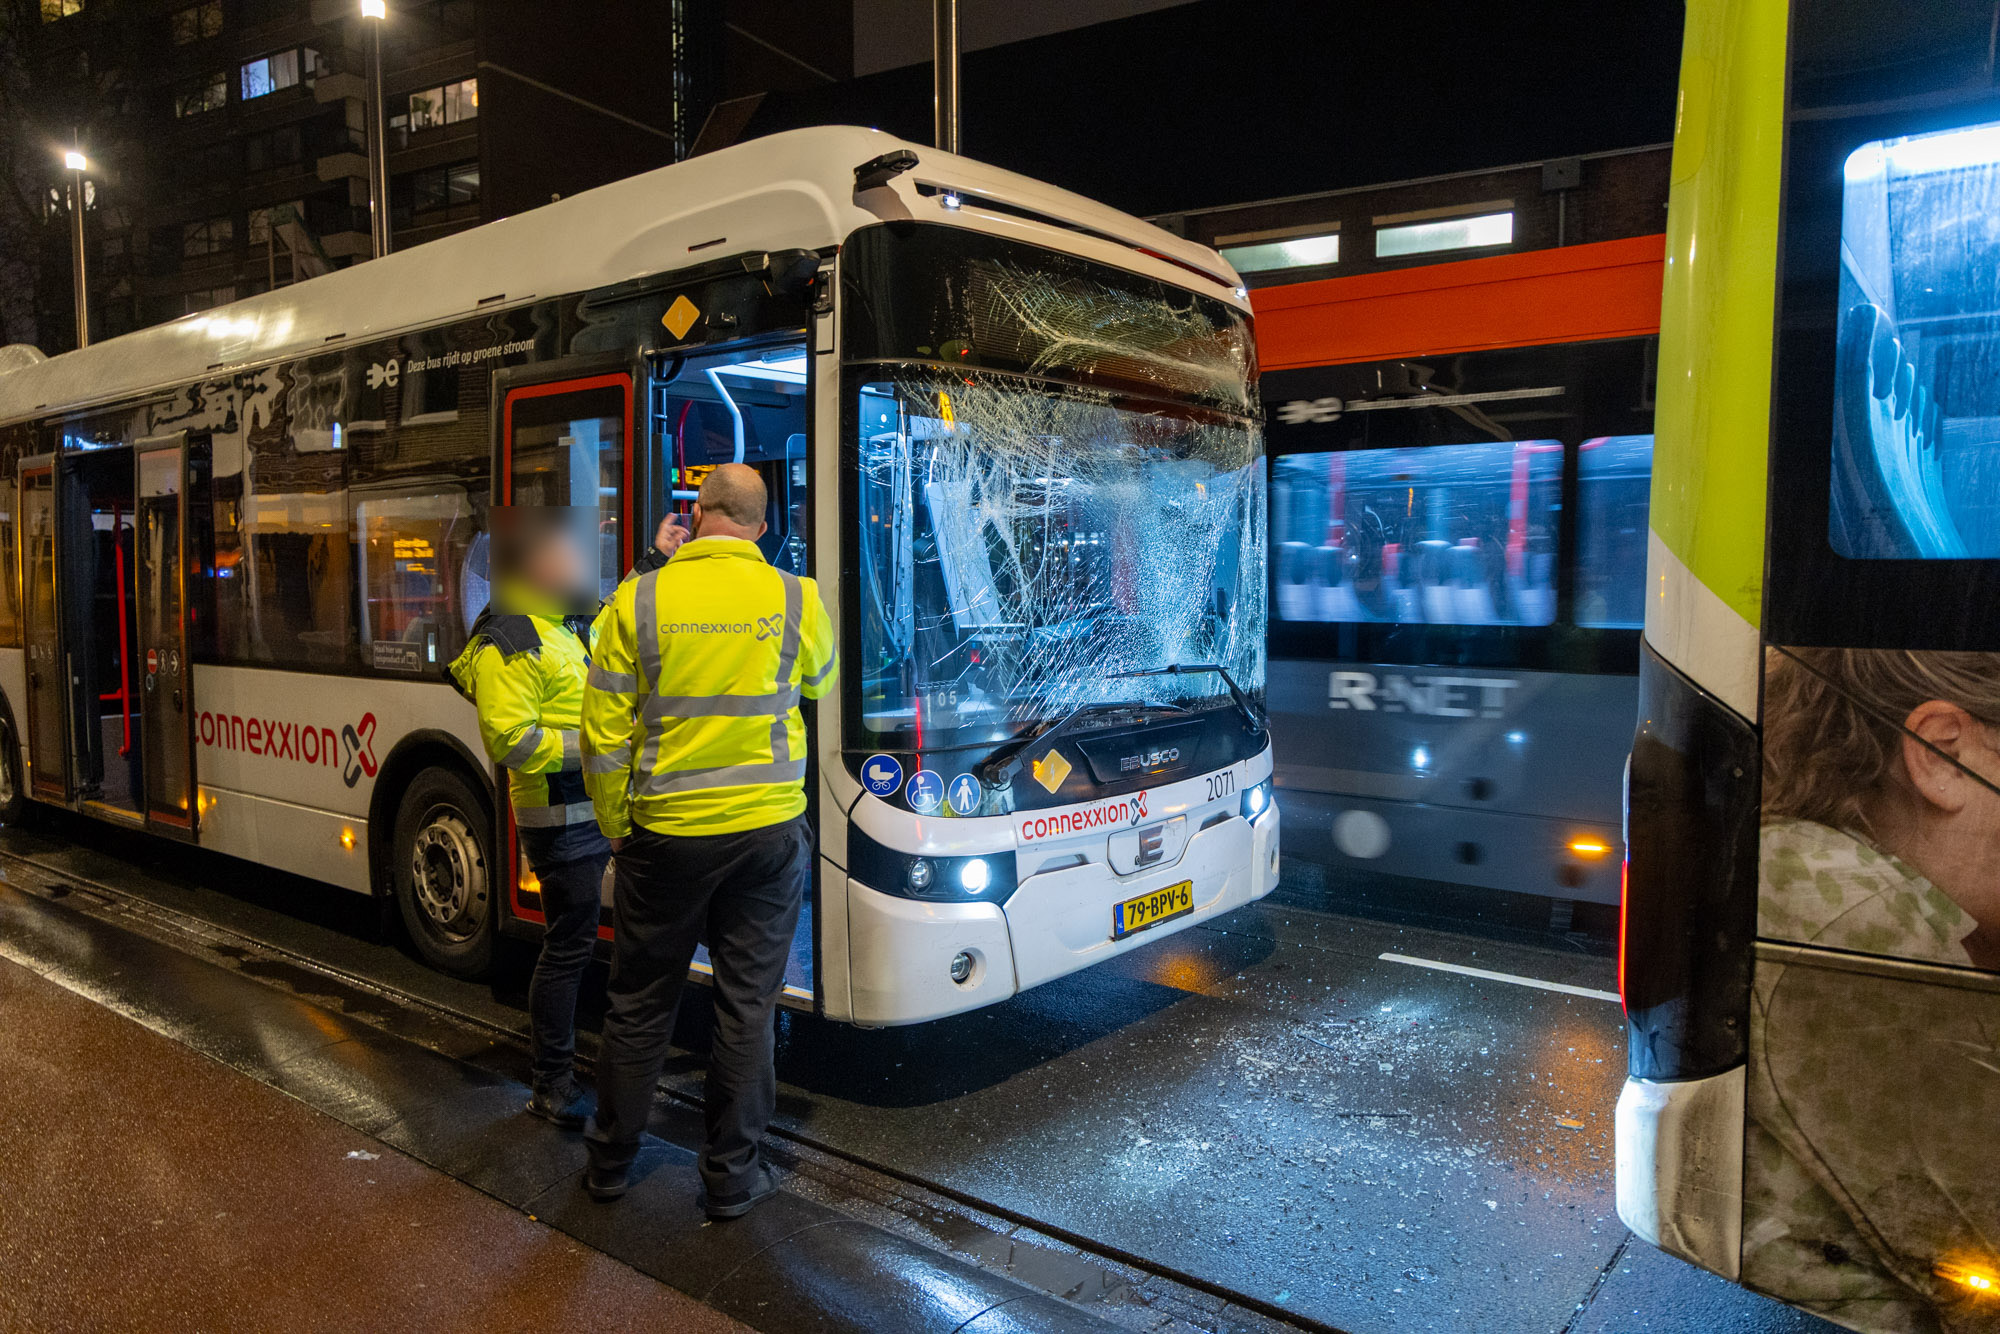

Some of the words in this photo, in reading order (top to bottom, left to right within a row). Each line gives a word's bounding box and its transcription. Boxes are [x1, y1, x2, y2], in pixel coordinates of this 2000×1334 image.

[407, 360, 426, 373] Deze
[427, 355, 441, 369] bus
[443, 350, 460, 368] rijdt
[461, 352, 472, 365] op
[473, 345, 502, 363] groene
[504, 339, 535, 355] stroom
[660, 622, 752, 634] connexxion
[1120, 747, 1180, 771] EBUSCO
[1206, 769, 1235, 802] 2071
[1022, 803, 1128, 840] connexxion
[1128, 885, 1188, 925] 79-BPV-6
